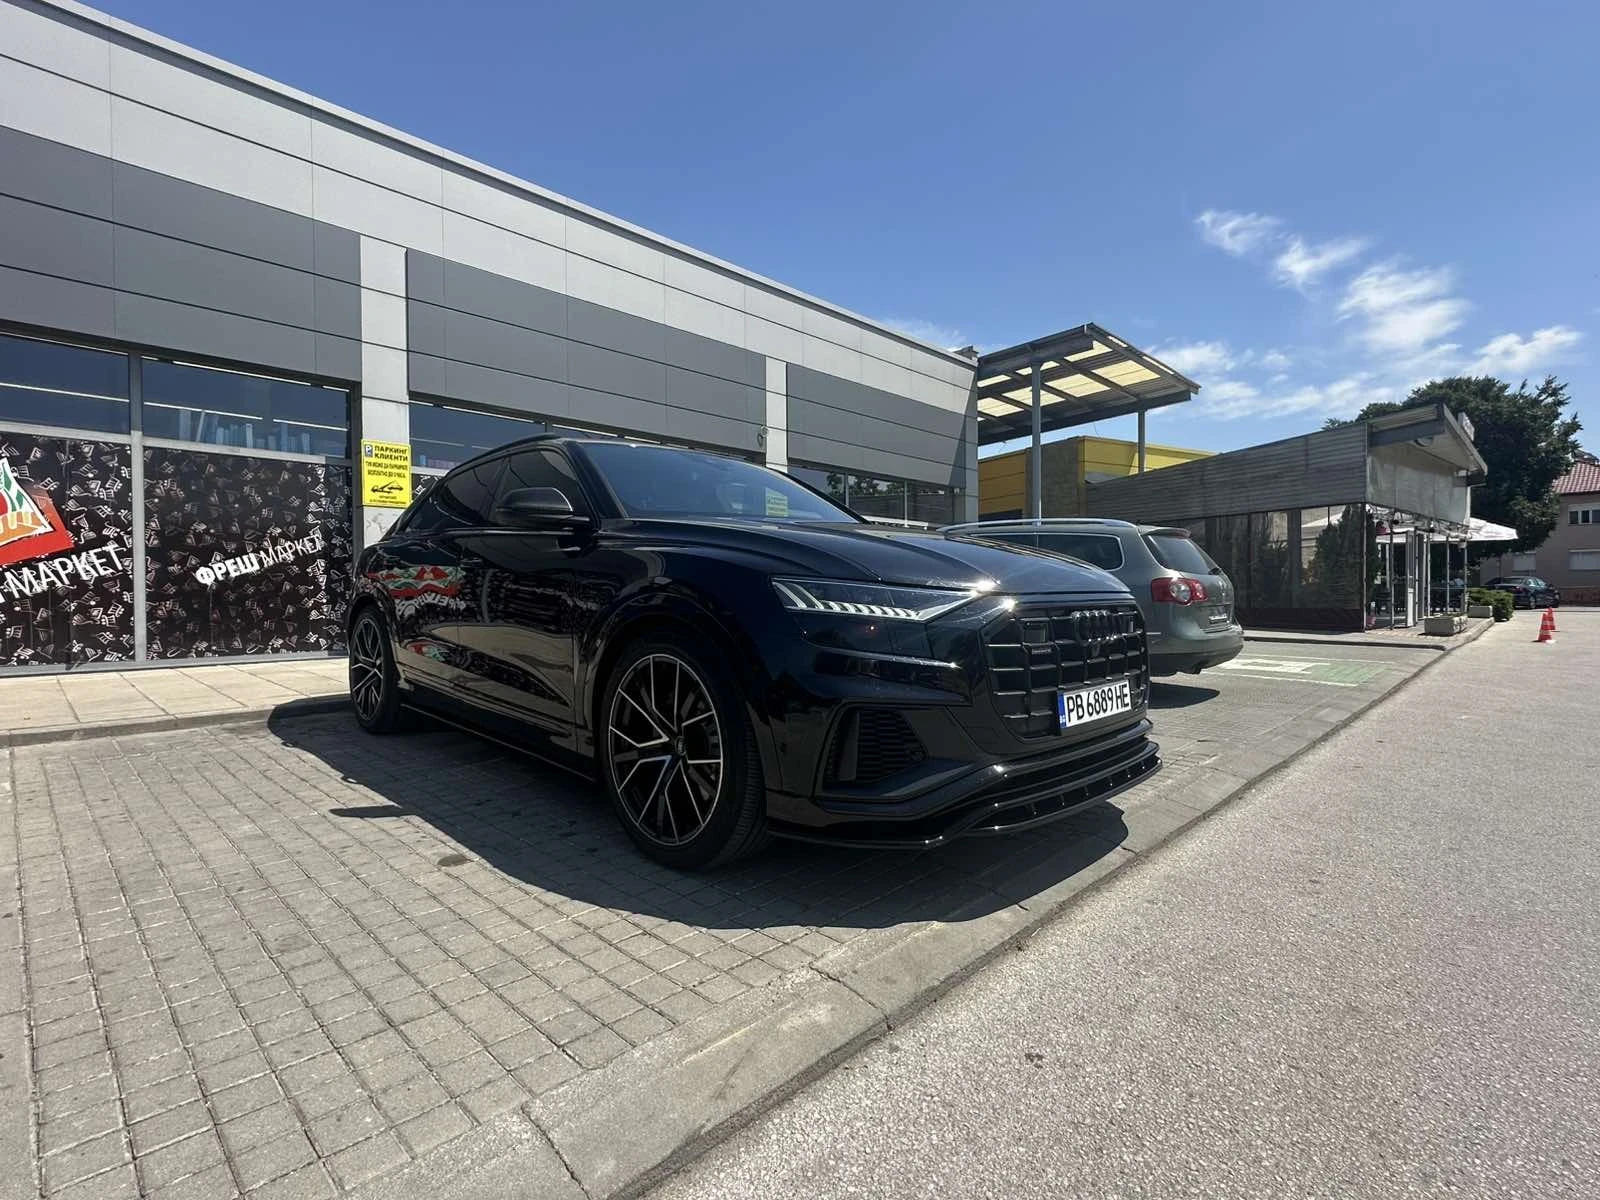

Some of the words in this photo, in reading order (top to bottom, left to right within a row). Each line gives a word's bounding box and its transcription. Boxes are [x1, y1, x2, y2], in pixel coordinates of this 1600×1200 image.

[374, 445, 407, 455] ПАРКИНГ
[374, 453, 408, 462] КЛИЕНТИ
[4, 544, 124, 599] МАРКЕТ
[194, 552, 261, 586] ФРЕШ
[259, 534, 322, 569] МАРКЕТ
[1066, 693, 1085, 723] PB
[1086, 687, 1114, 717] 6889
[1114, 683, 1130, 711] HE
